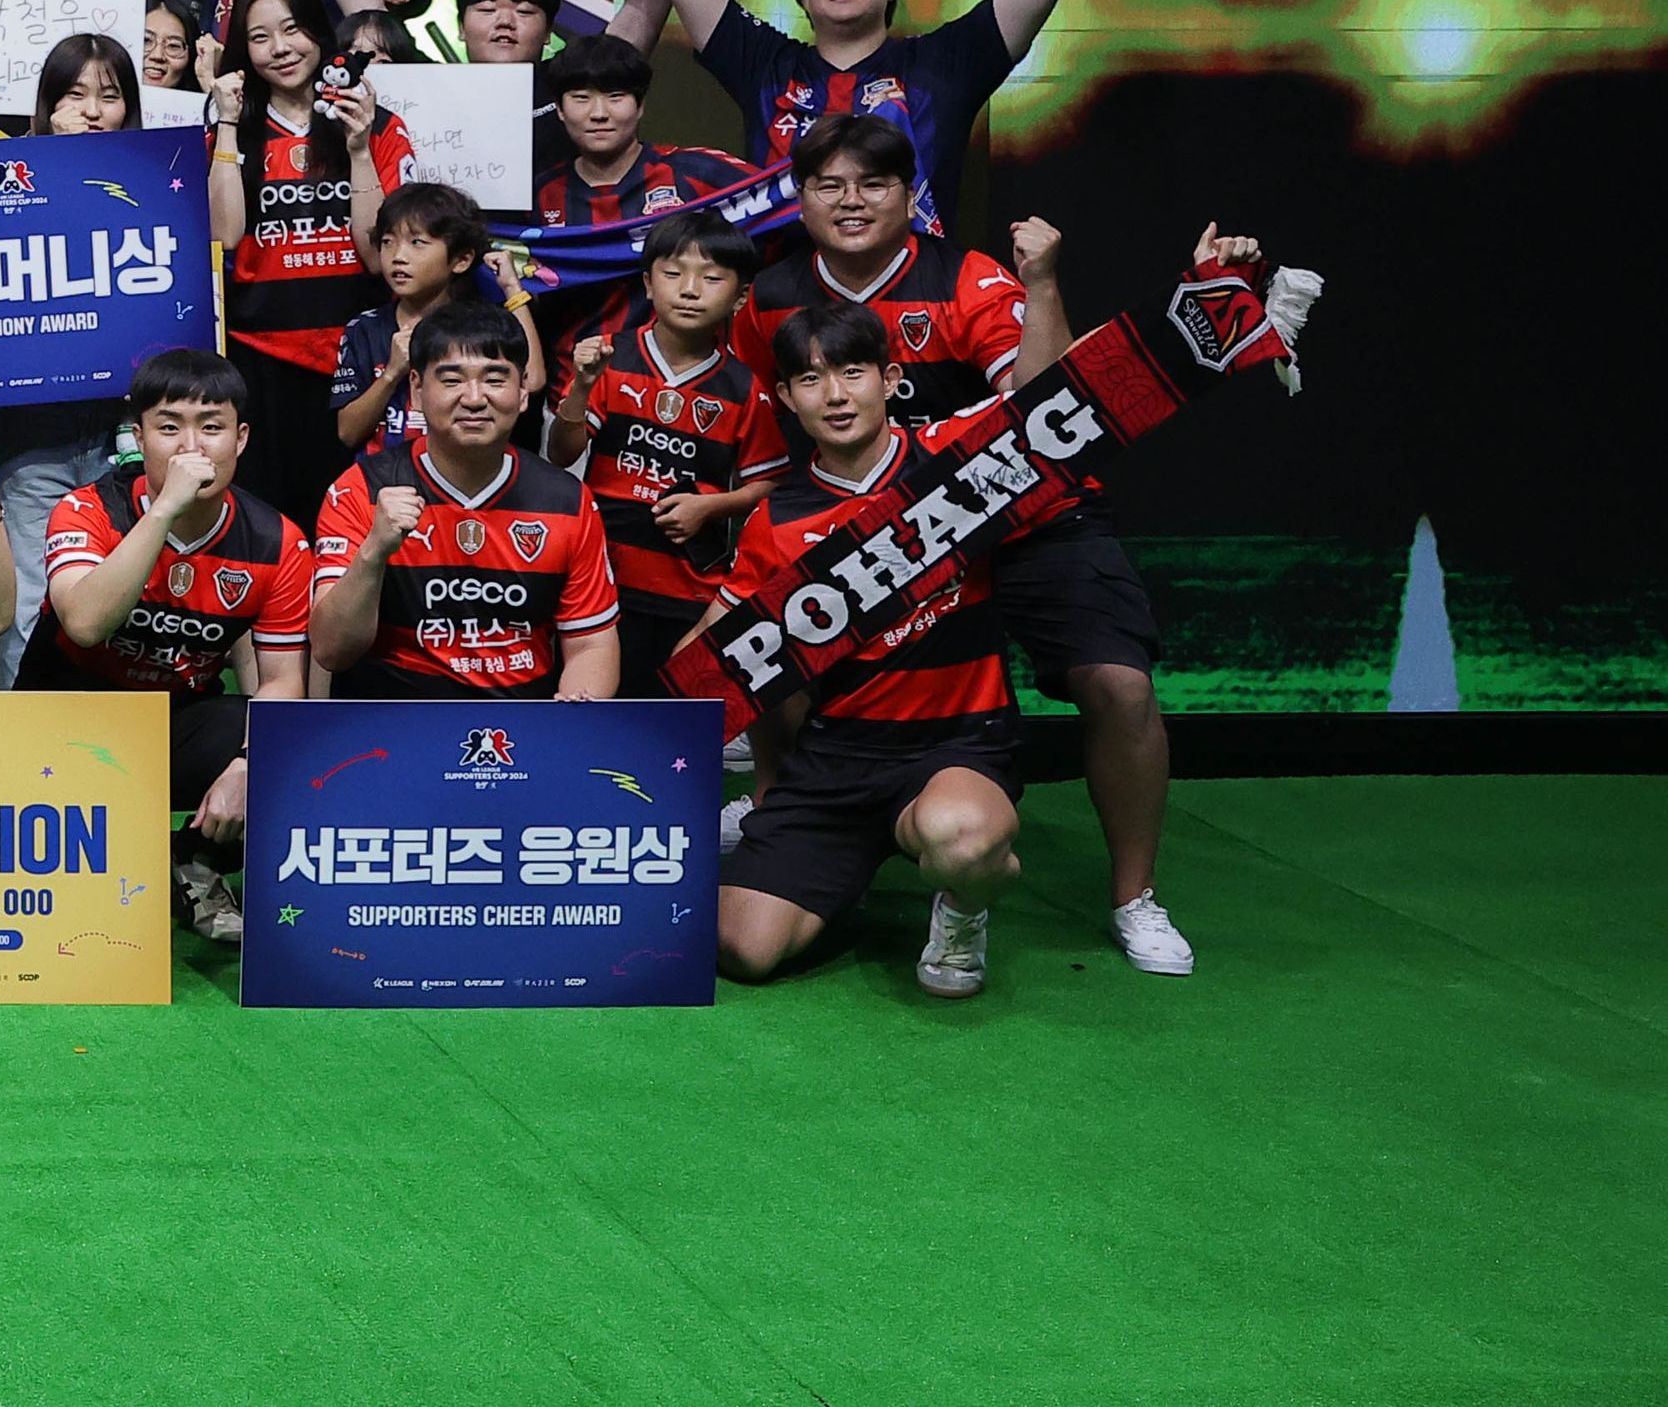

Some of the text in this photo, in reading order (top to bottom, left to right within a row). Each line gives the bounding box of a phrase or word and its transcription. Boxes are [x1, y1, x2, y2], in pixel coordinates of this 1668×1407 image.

[40, 311, 99, 337] AWARD
[722, 387, 1106, 692] POHANG
[425, 578, 528, 610] posco
[126, 608, 225, 642] posco
[277, 825, 691, 885] 서포터즈 응원상
[347, 904, 622, 928] SUPPORTERS CHEER AWARD
